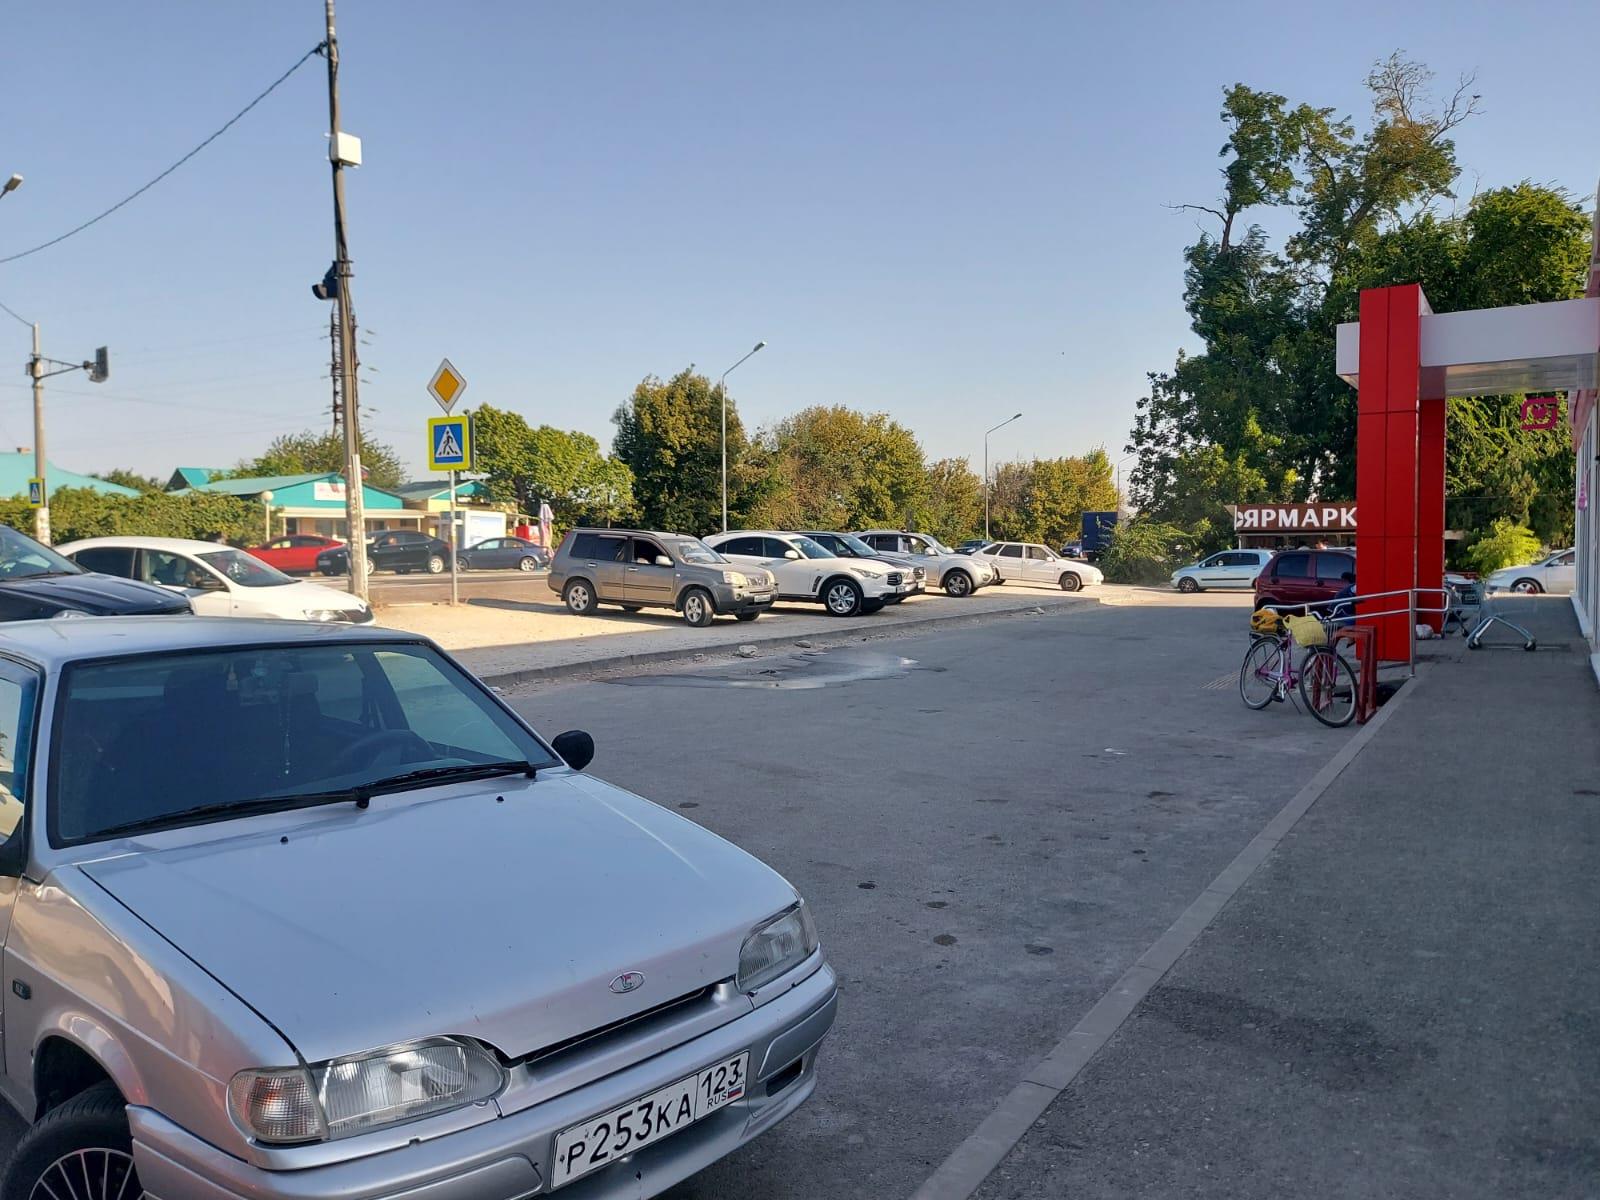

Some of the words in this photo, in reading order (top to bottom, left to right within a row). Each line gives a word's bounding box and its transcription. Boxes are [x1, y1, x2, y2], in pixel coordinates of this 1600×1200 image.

[1243, 506, 1357, 528] ЯРМАРК
[706, 1089, 728, 1109] RUS
[566, 1093, 692, 1175] Р253КА
[701, 1058, 741, 1099] 123
